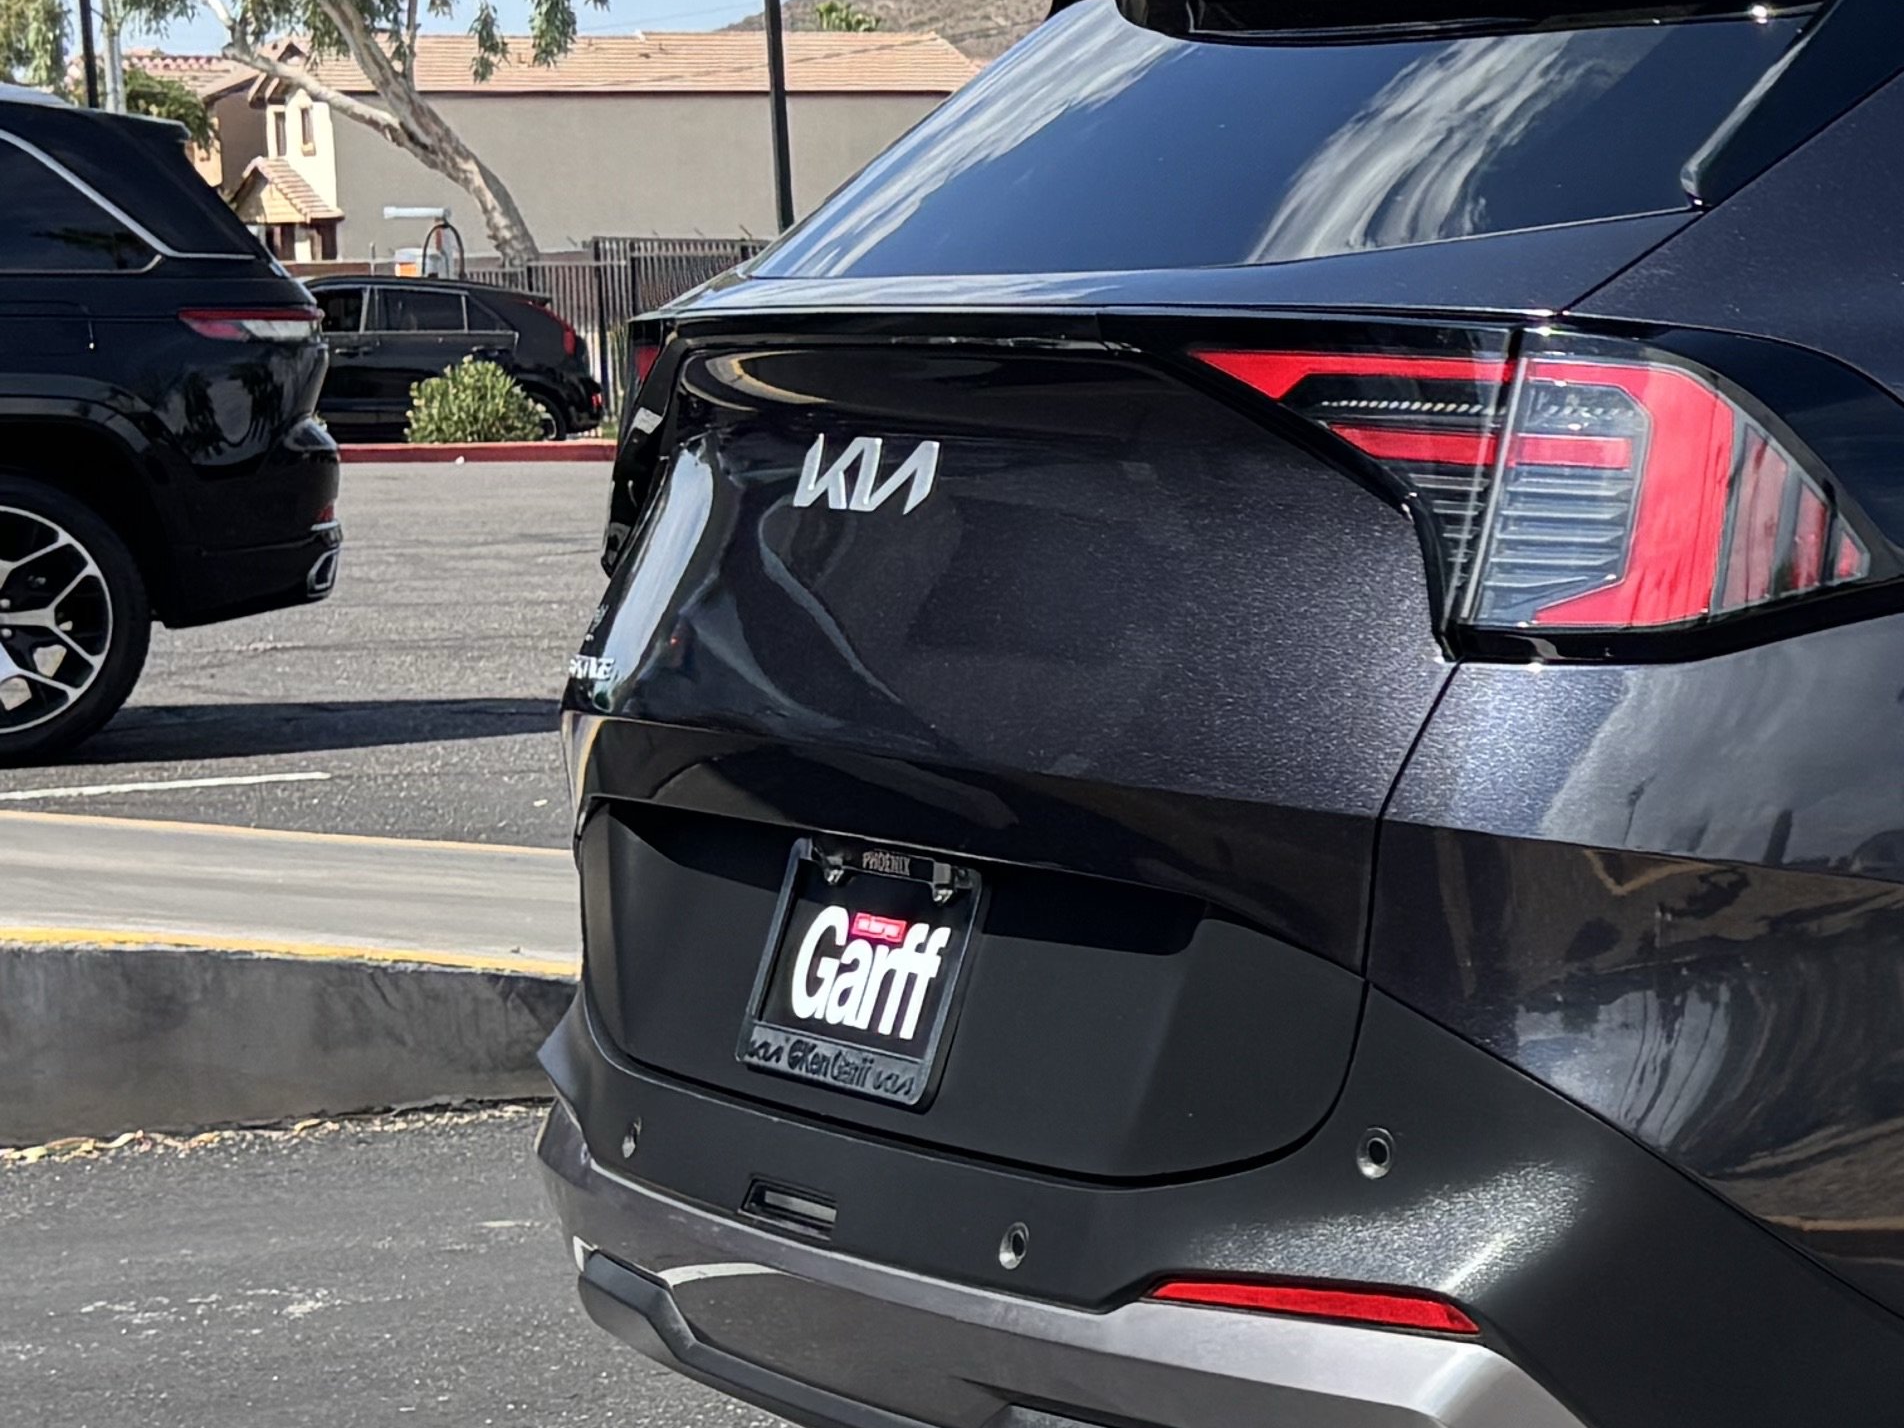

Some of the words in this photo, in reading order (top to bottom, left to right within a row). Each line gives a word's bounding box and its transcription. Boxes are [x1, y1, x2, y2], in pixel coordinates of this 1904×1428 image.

[793, 433, 940, 515] KIA
[862, 851, 911, 876] PHOENIX
[792, 906, 951, 1040] Garff
